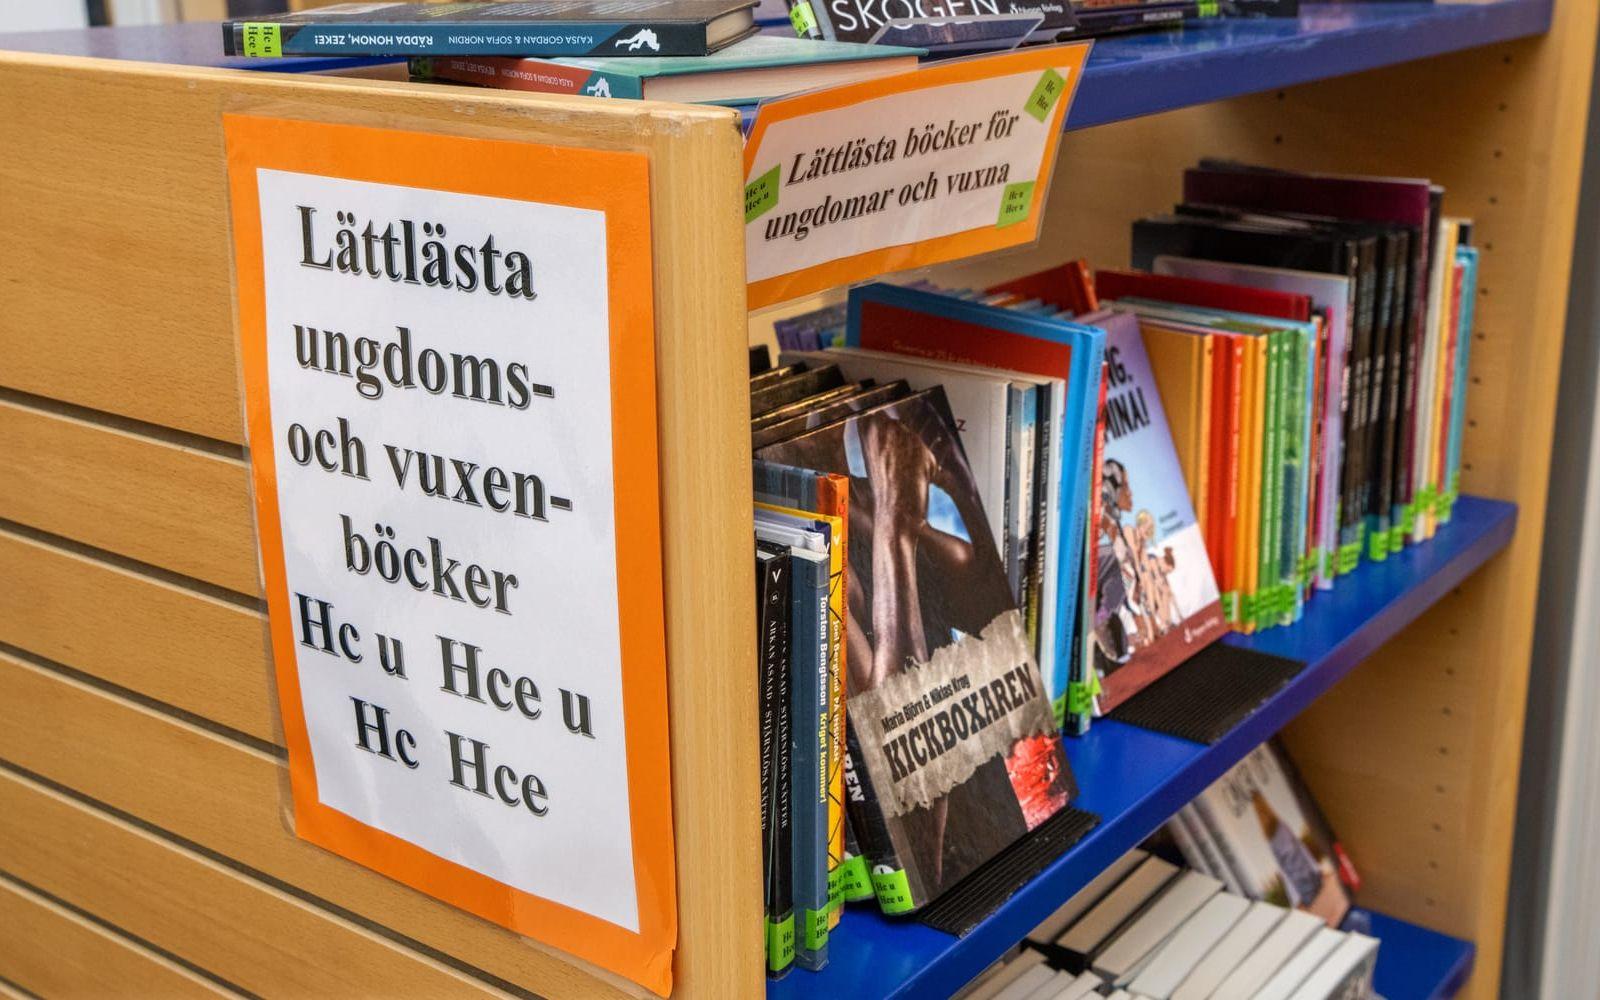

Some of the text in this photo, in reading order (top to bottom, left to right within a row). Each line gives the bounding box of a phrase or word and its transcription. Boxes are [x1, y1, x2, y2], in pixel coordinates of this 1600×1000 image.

[248, 26, 258, 48] Hce
[263, 26, 273, 42] Hc
[314, 33, 434, 48] RÄDDA HONOM, ZEKE!
[448, 36, 593, 45] KAJSA GORDAN & SOFIA NORDIN
[832, 0, 1000, 31] SKOGEN
[785, 109, 1020, 187] Lättlästa böcker för
[765, 161, 1010, 241] ungdomar och vuxna
[295, 204, 537, 300] Lättlästa
[292, 323, 555, 411] ungdoms-
[287, 416, 573, 522] och vuxen-
[338, 513, 519, 616] böcker
[294, 591, 596, 739] Hc u Hce u
[766, 621, 776, 699] ARKAN ASAAD
[819, 595, 829, 706] Torsten Bengtsson
[832, 619, 840, 641] Joel
[819, 713, 827, 748] Kriget
[881, 711, 906, 734] Maria
[903, 701, 925, 721] Björn
[922, 694, 932, 710] &
[929, 684, 953, 706] Niklas
[882, 662, 1037, 784] KICKBOXAREN
[348, 695, 550, 817] Hc Hce
